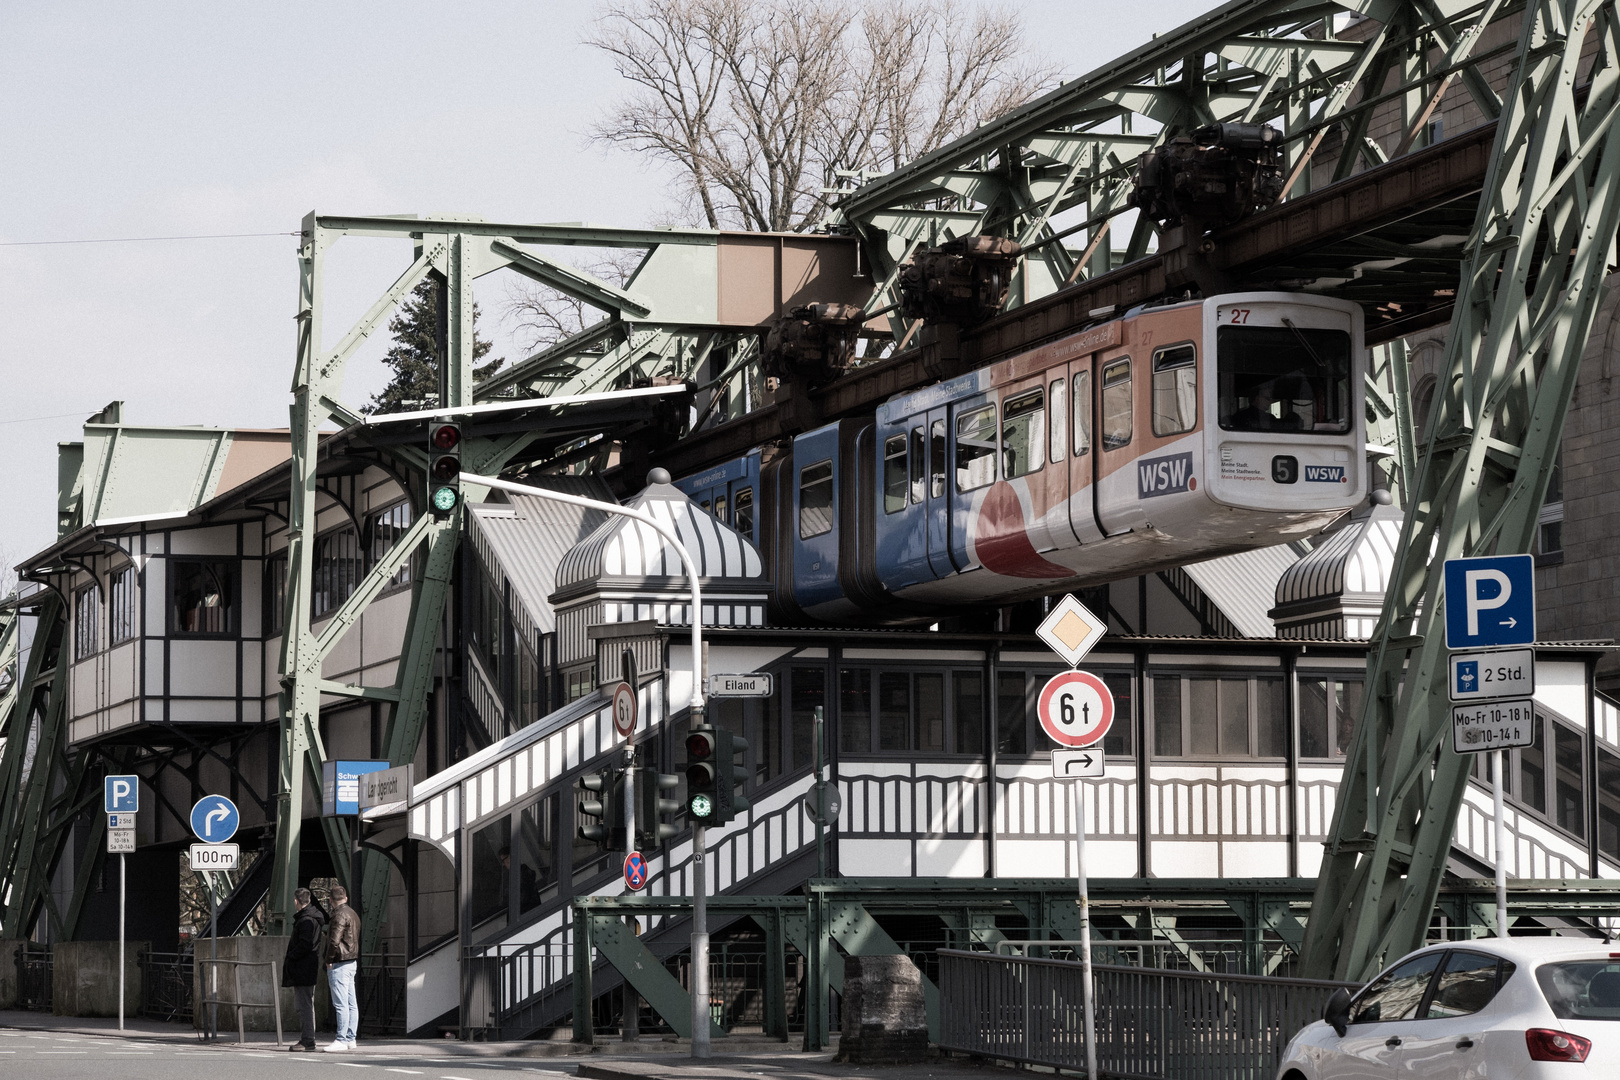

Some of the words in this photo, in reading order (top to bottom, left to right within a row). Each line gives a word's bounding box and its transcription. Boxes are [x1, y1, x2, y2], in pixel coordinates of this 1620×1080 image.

[1231, 309, 1250, 324] 27
[1142, 331, 1153, 346] 27
[1276, 460, 1290, 481] 5
[1465, 569, 1512, 636] P
[1484, 668, 1493, 682] 2
[1497, 666, 1526, 681] Std.
[725, 680, 756, 690] Eiland
[619, 698, 624, 721] 6
[626, 707, 629, 721] t
[1060, 693, 1075, 725] 6
[1082, 701, 1089, 724] t
[1456, 711, 1486, 726] Mo-Fr
[1490, 708, 1521, 723] 10-18
[1523, 707, 1530, 721] h
[1481, 727, 1511, 743] 10-14
[1514, 727, 1520, 740] h
[113, 780, 130, 808] P
[196, 851, 218, 863] 100
[220, 854, 233, 863] m
